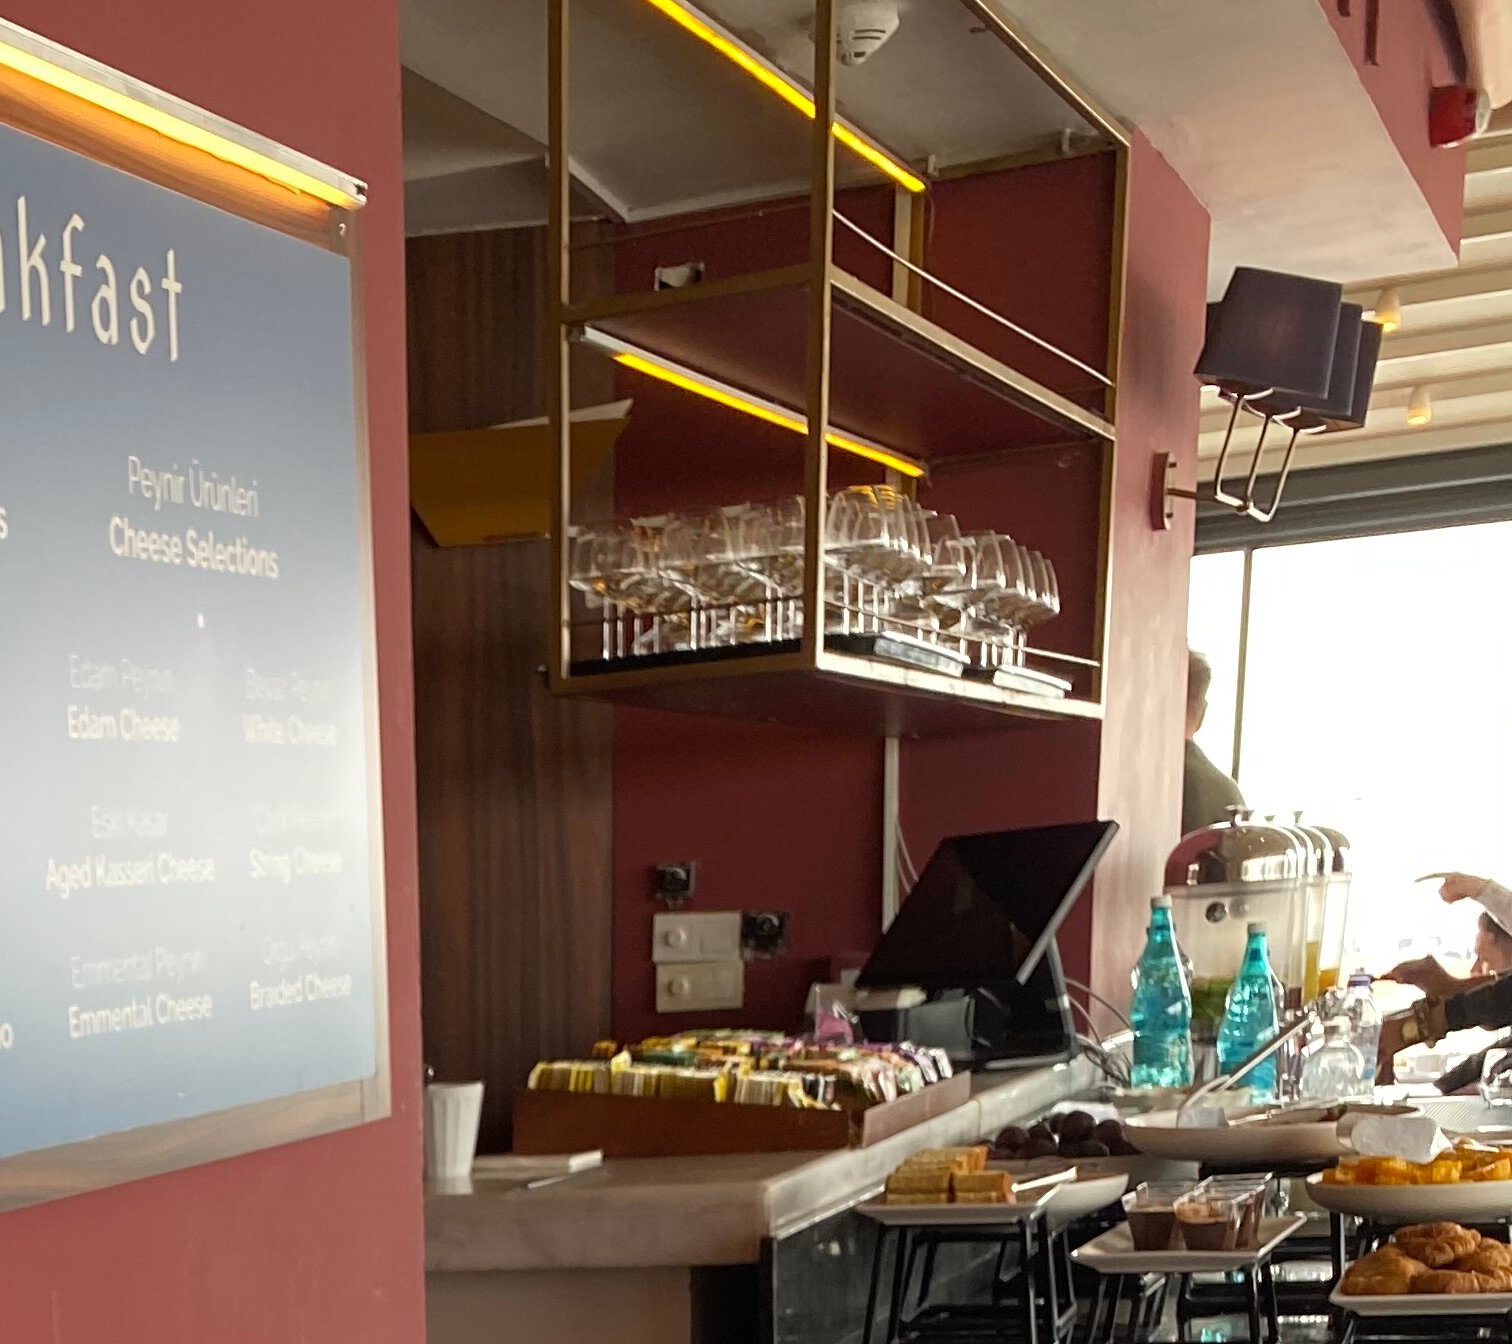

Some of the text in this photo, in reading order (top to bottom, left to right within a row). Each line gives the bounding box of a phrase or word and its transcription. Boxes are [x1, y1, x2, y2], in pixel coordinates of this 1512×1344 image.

[189, 459, 259, 517] Ürünleri
[109, 515, 279, 580] Cheese Selections
[120, 707, 180, 742] Cheese
[157, 852, 216, 885] Cheese
[69, 993, 213, 1038] Emmental Cheese
